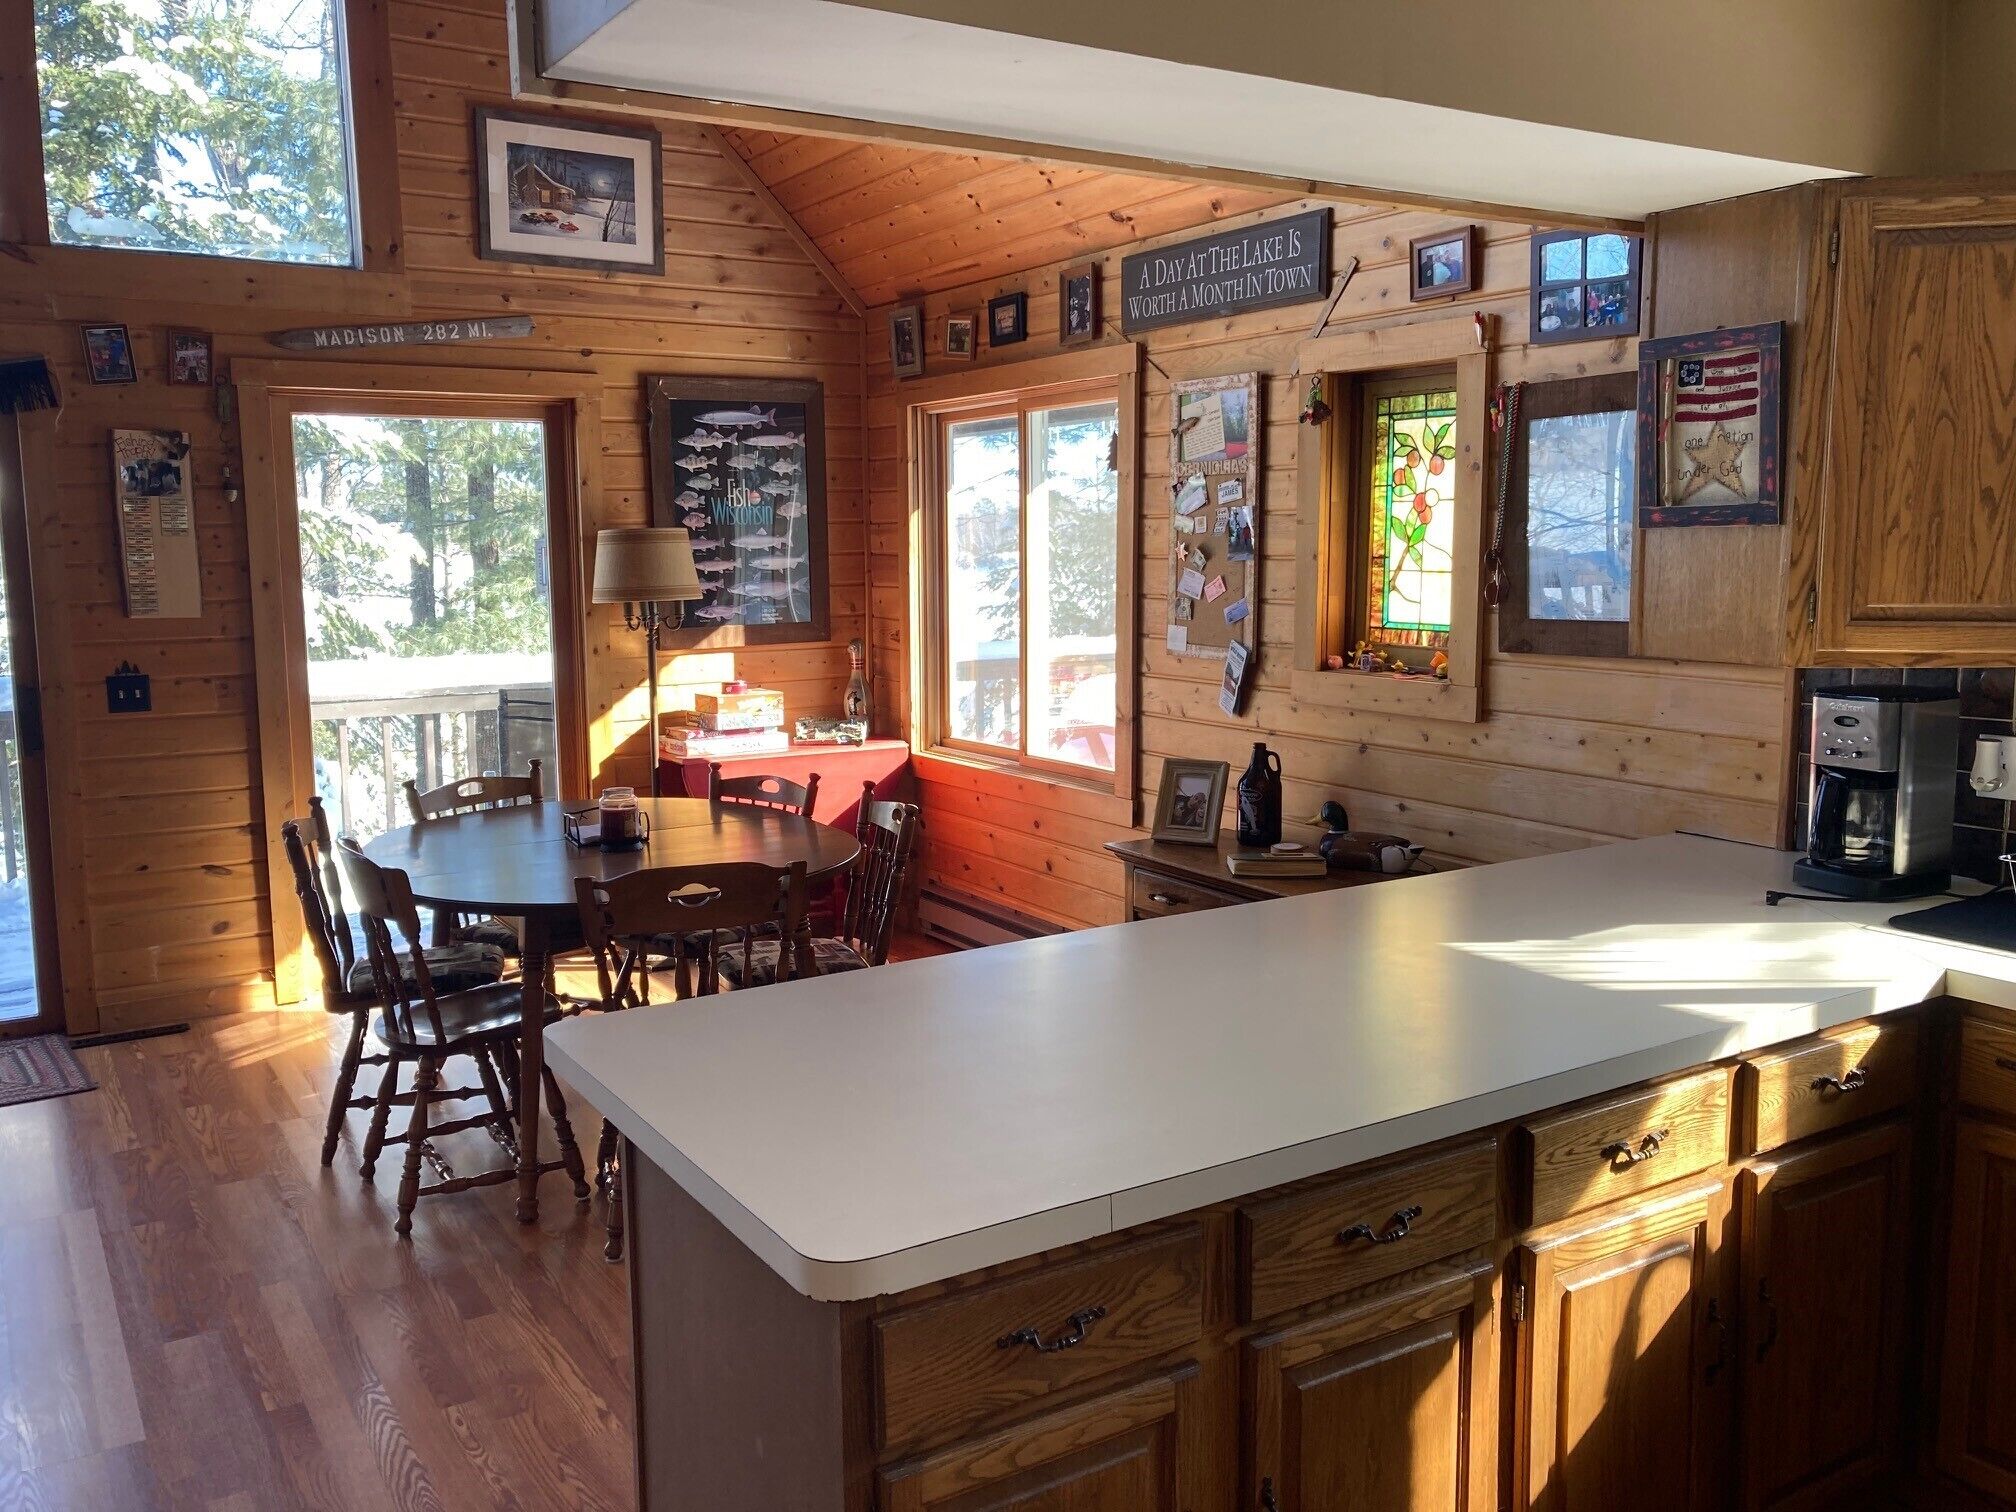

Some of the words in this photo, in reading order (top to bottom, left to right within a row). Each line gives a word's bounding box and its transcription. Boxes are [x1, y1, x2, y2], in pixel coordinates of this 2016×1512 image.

[1139, 263, 1150, 290] A
[1129, 291, 1176, 320] WORTH
[1179, 285, 1189, 310] A
[1191, 278, 1244, 308] MONTH
[1265, 264, 1312, 294] TOWN
[313, 326, 405, 347] MADISON
[423, 323, 460, 341] 282
[1684, 437, 1703, 451] one
[1717, 430, 1754, 445] nation
[1719, 460, 1743, 477] God
[727, 478, 751, 507] Fish
[1221, 487, 1239, 498] JAMES
[711, 496, 773, 526] Wisconsin
